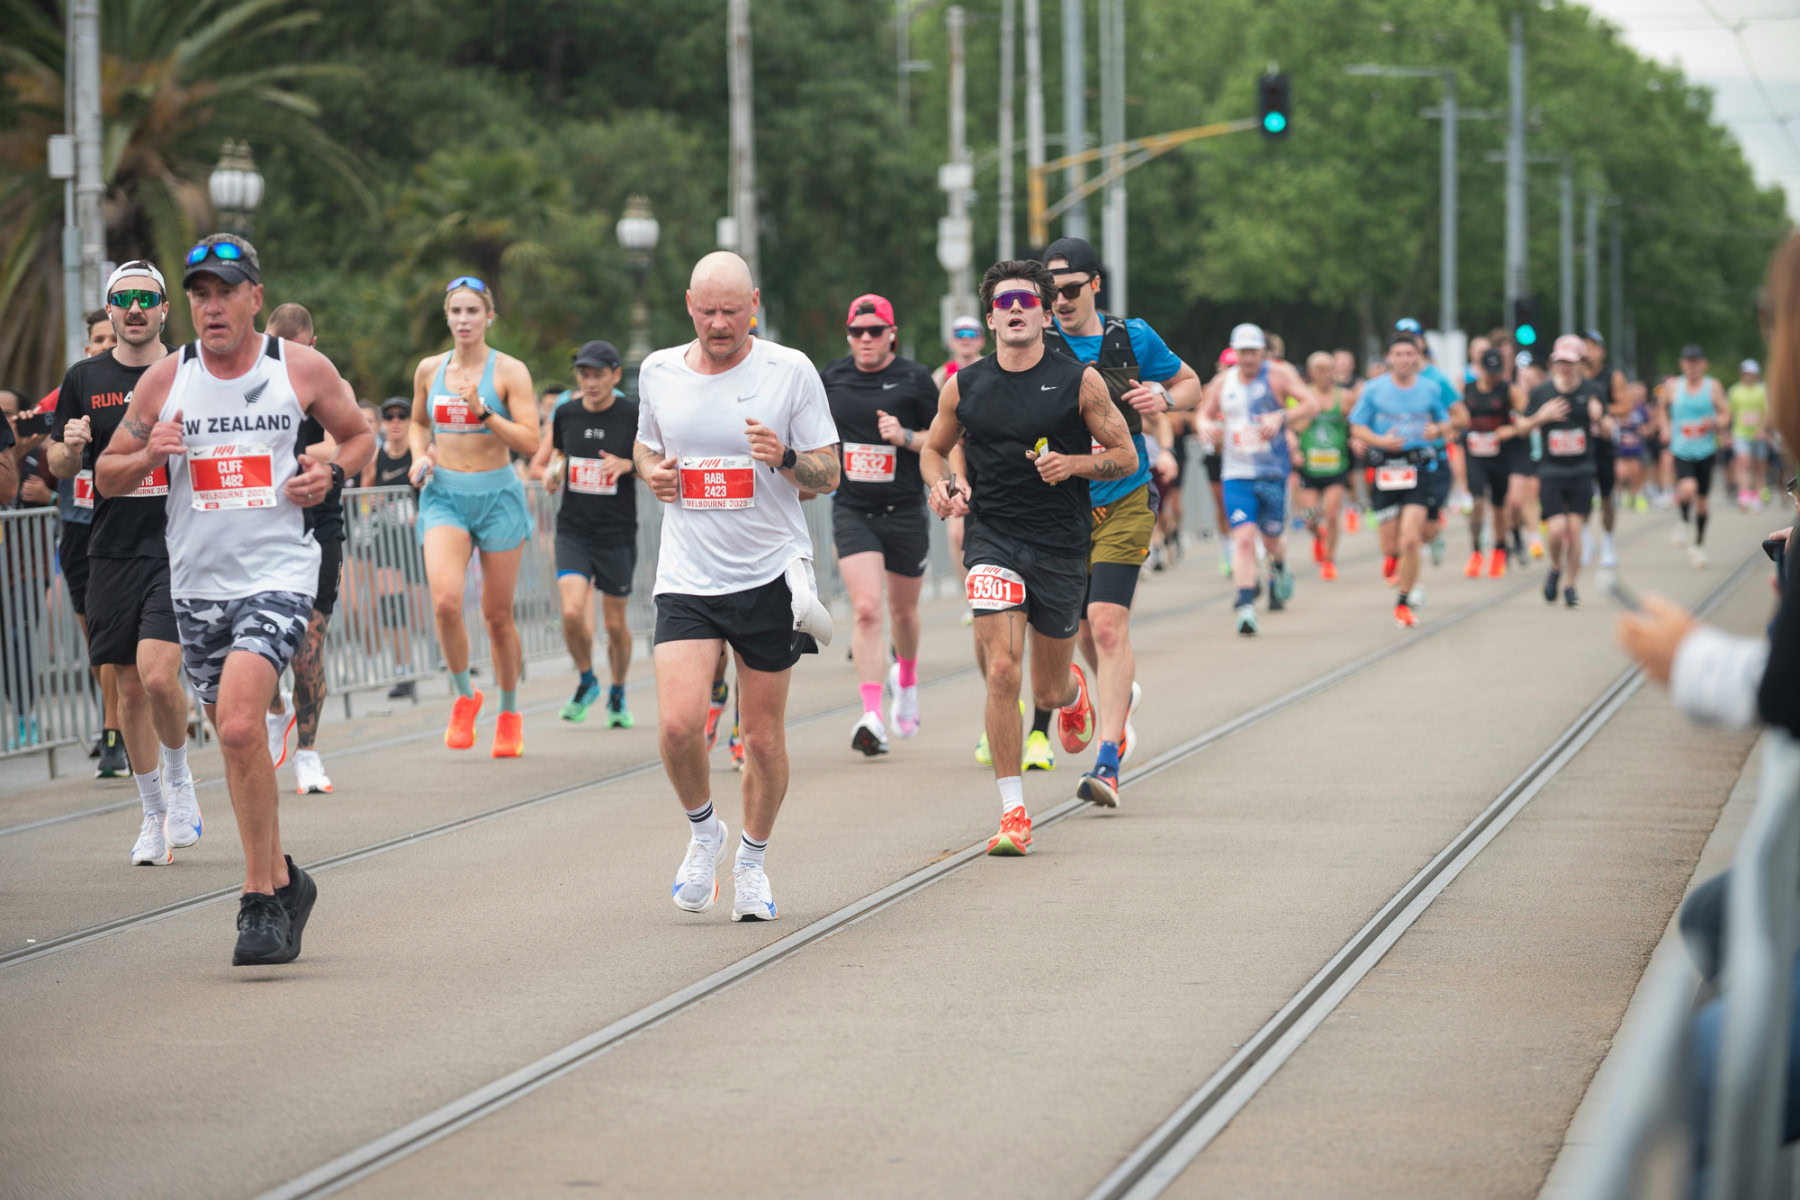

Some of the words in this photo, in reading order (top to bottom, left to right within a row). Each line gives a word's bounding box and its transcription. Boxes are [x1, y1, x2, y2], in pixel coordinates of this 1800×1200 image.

[207, 414, 291, 434] ZEALAND
[217, 459, 243, 474] CLIFF
[851, 452, 887, 474] 9632
[219, 474, 244, 488] 1482
[704, 472, 727, 485] RABL
[200, 490, 244, 501] MELBOURNE
[704, 485, 727, 498] 2423
[686, 500, 727, 508] MELBOURNE
[973, 575, 1011, 601] 5301
